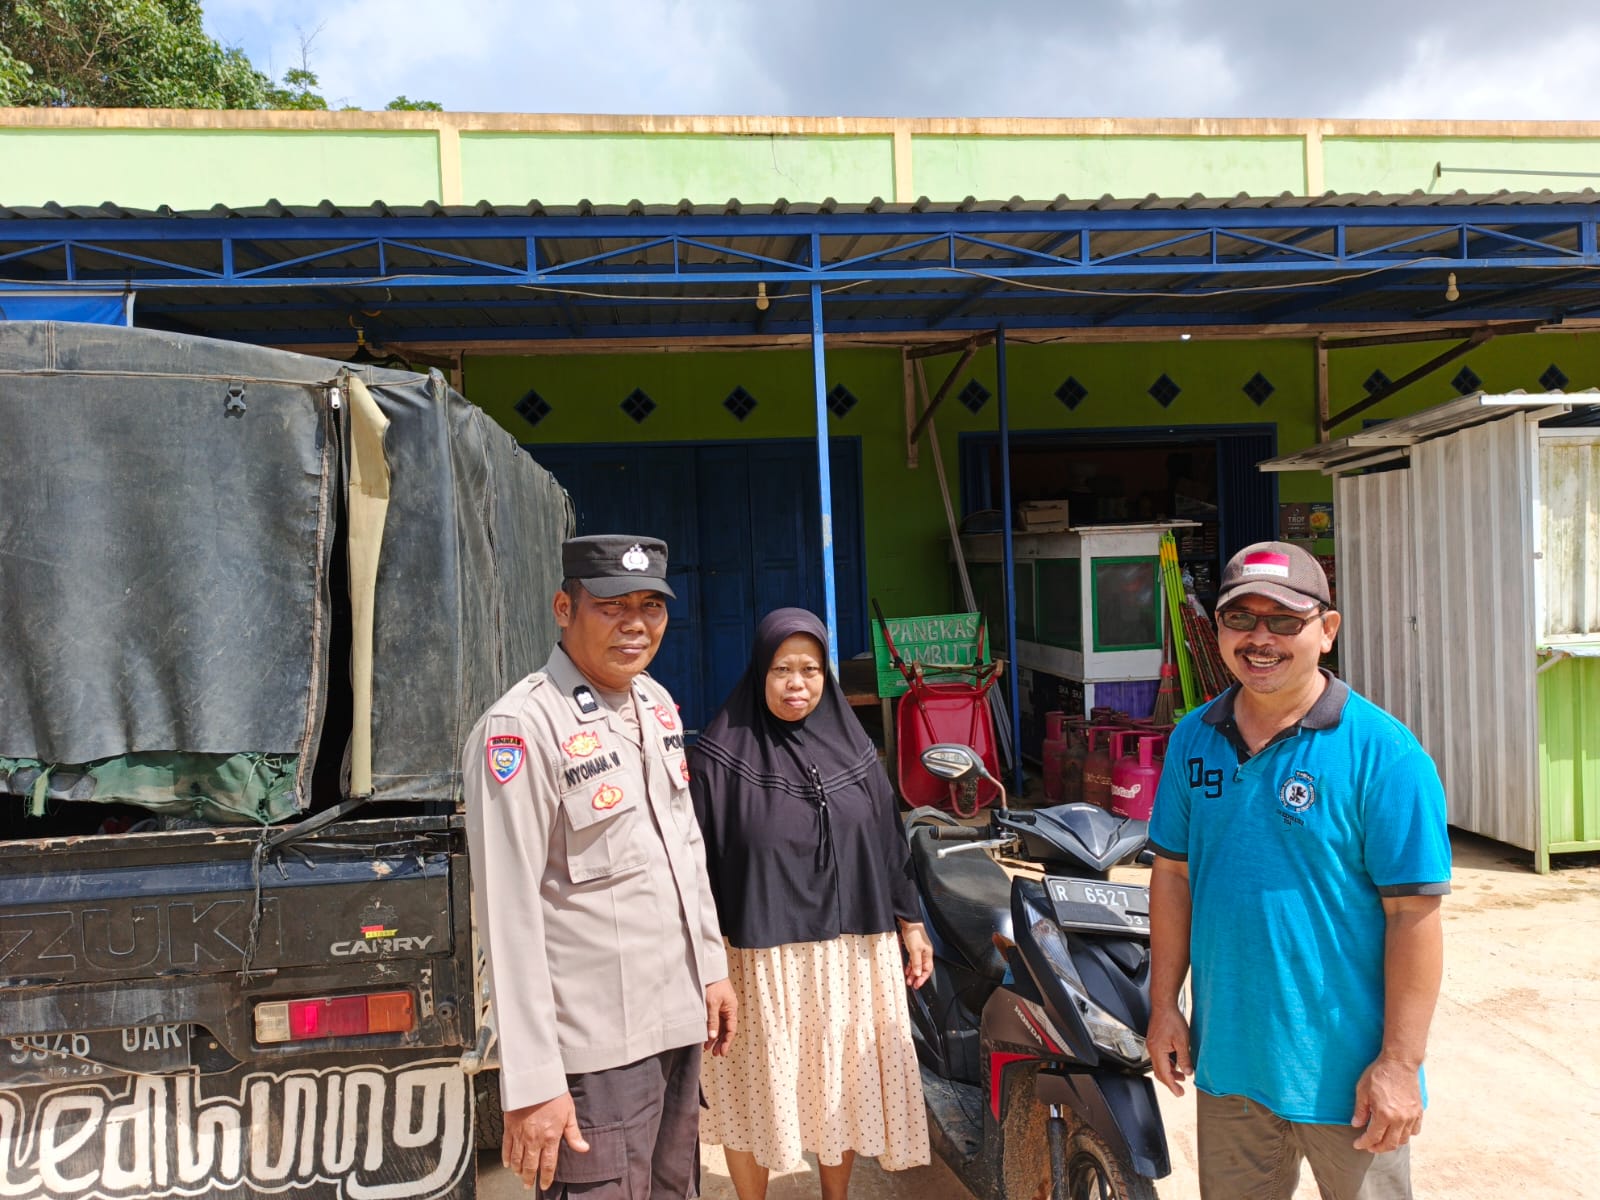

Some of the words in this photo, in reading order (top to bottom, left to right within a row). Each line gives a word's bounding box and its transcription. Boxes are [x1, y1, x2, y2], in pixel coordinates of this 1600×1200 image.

[888, 617, 977, 642] PANGKAS
[1055, 885, 1069, 902] R
[1084, 887, 1129, 908] 6527
[330, 935, 434, 957] CARRY
[1014, 1005, 1043, 1047] HONDA
